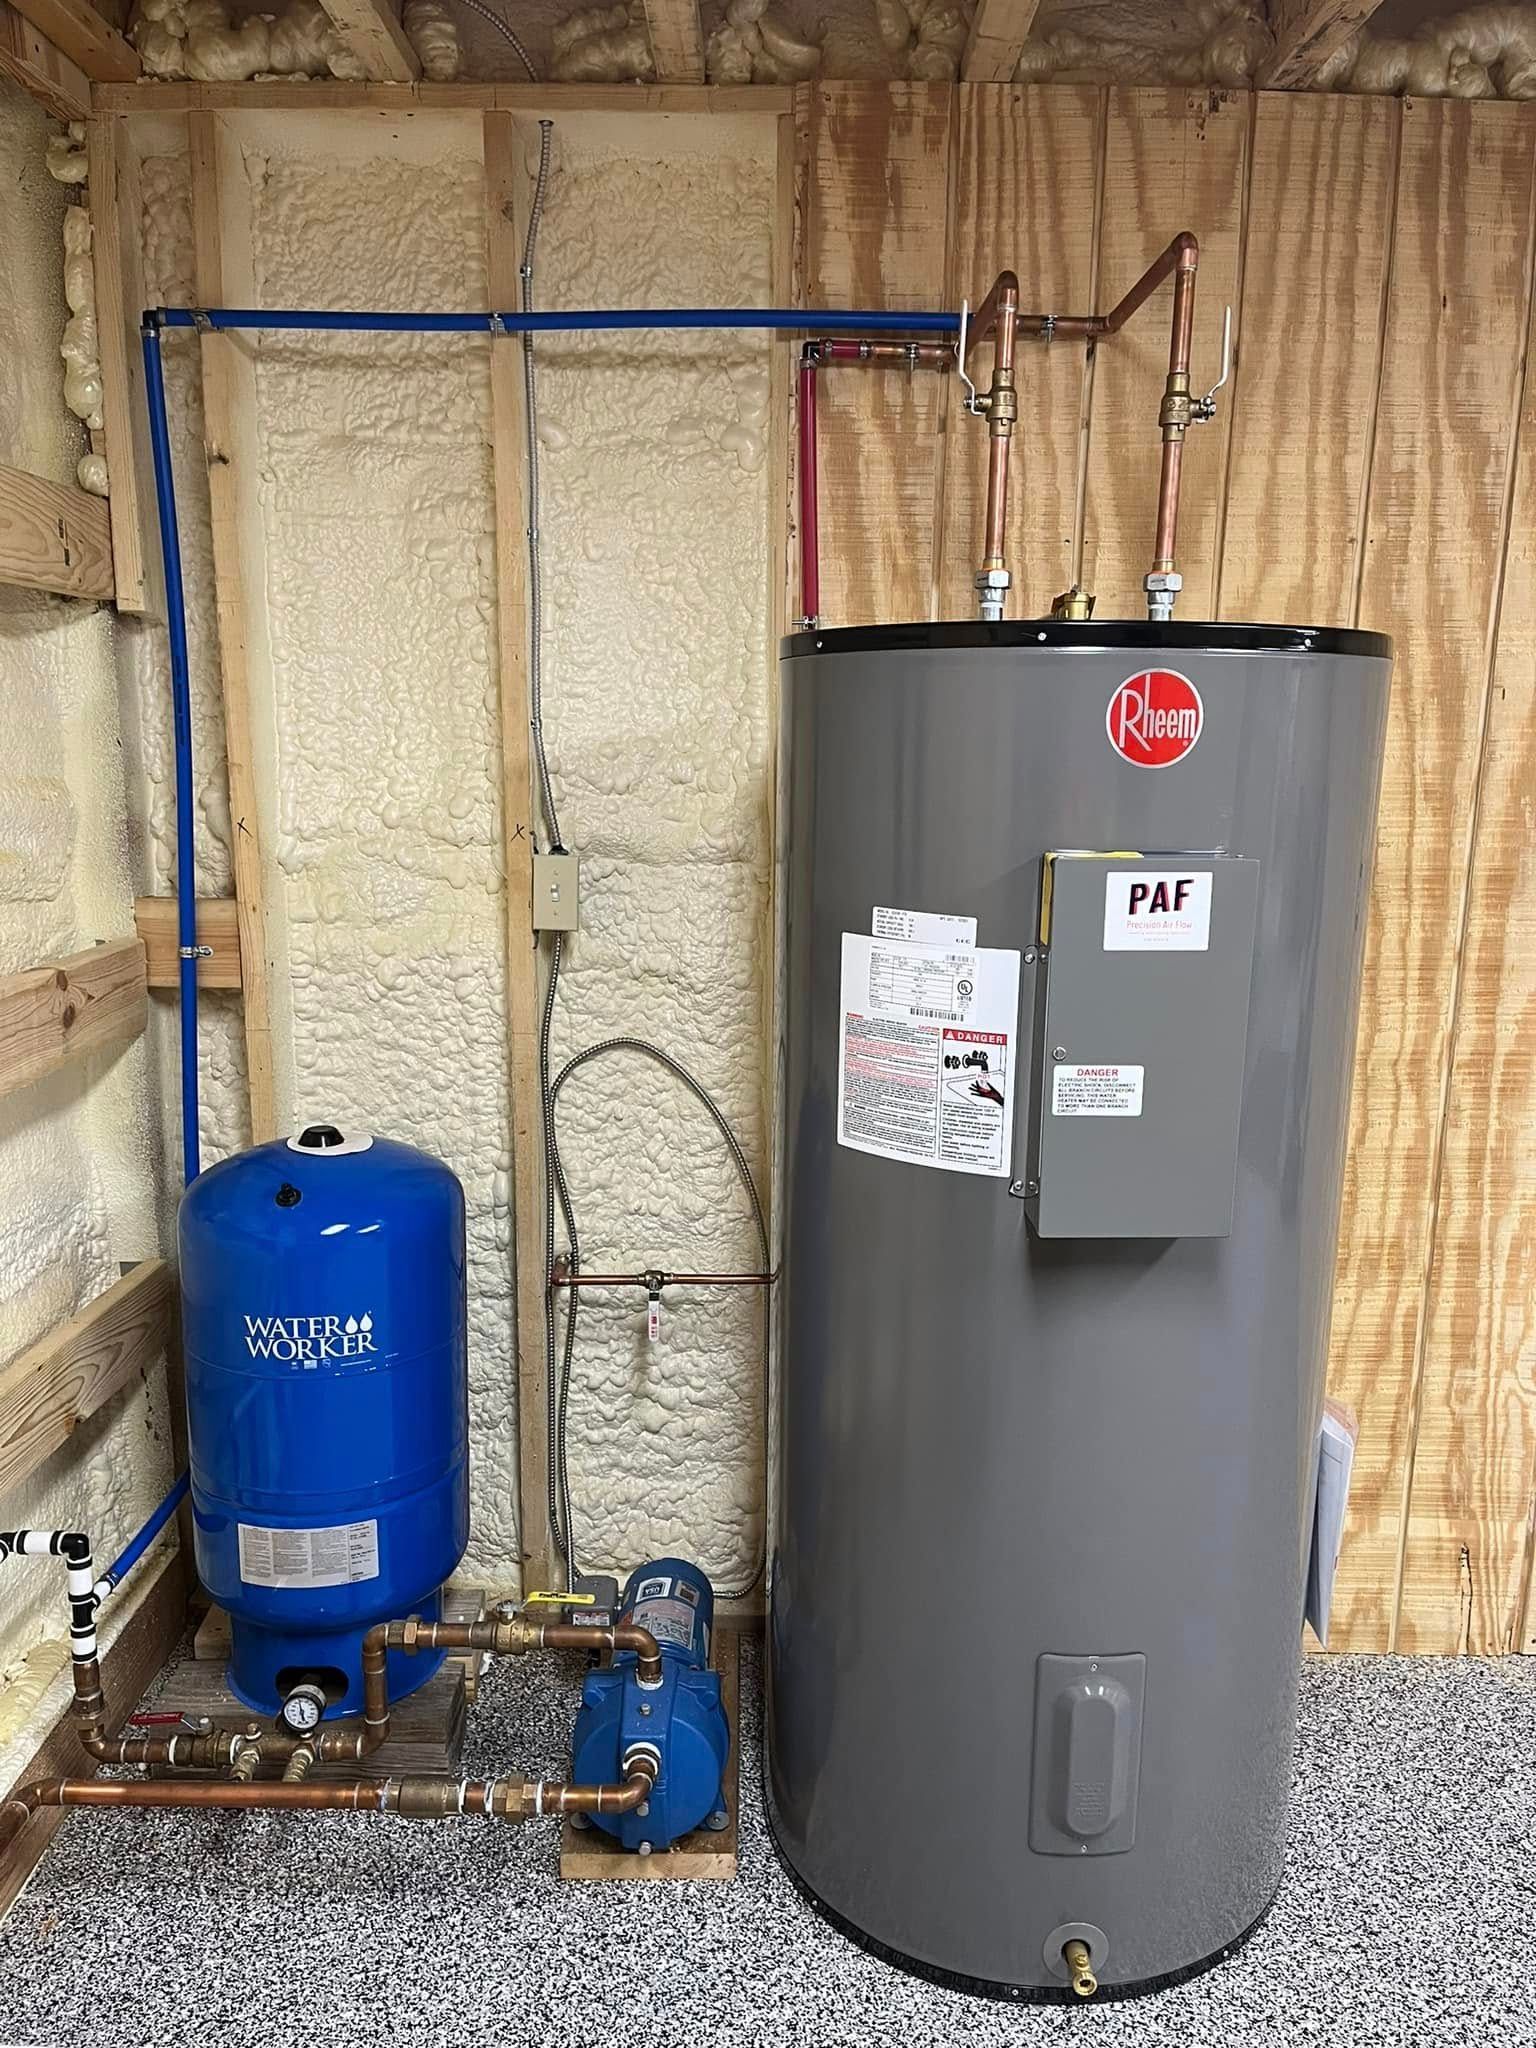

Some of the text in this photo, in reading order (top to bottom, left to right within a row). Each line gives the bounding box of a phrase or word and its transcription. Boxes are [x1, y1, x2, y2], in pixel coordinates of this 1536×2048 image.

[1119, 674, 1196, 751] Rheem
[1128, 879, 1194, 915] PAF
[1127, 920, 1192, 929] Precision Air Flow
[957, 1031, 1003, 1044] DANGER
[243, 1315, 346, 1339] WATER
[245, 1333, 378, 1360] WORKER
